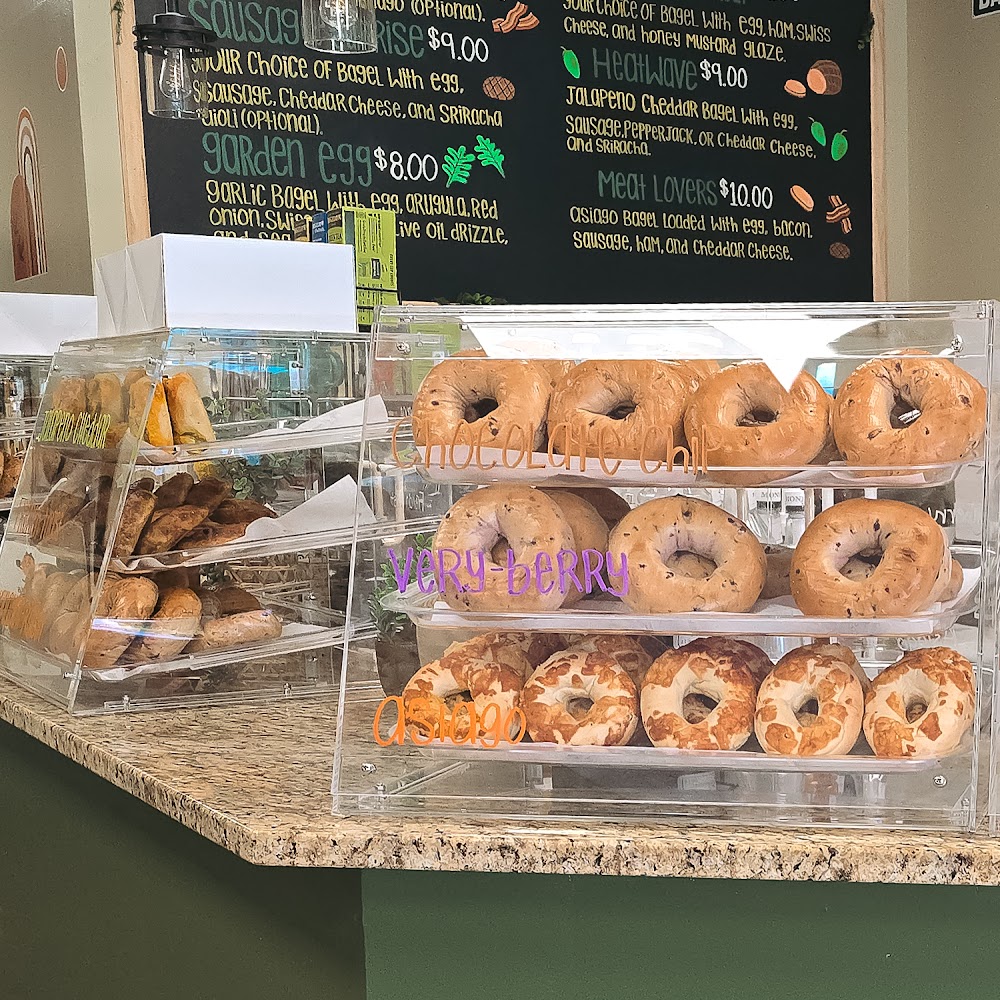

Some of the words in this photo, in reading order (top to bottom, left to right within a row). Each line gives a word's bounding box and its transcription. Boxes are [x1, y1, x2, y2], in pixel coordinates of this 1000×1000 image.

[427, 26, 489, 62] $9.00
[612, 23, 636, 41] and
[700, 59, 748, 89] $9.00
[408, 102, 435, 122] and
[566, 136, 593, 153] and
[318, 141, 373, 187] egg
[373, 146, 439, 182] $8.00
[598, 170, 646, 200] Meat
[719, 177, 774, 210] $10.00
[665, 237, 689, 255] and
[373, 695, 527, 748] asiago
